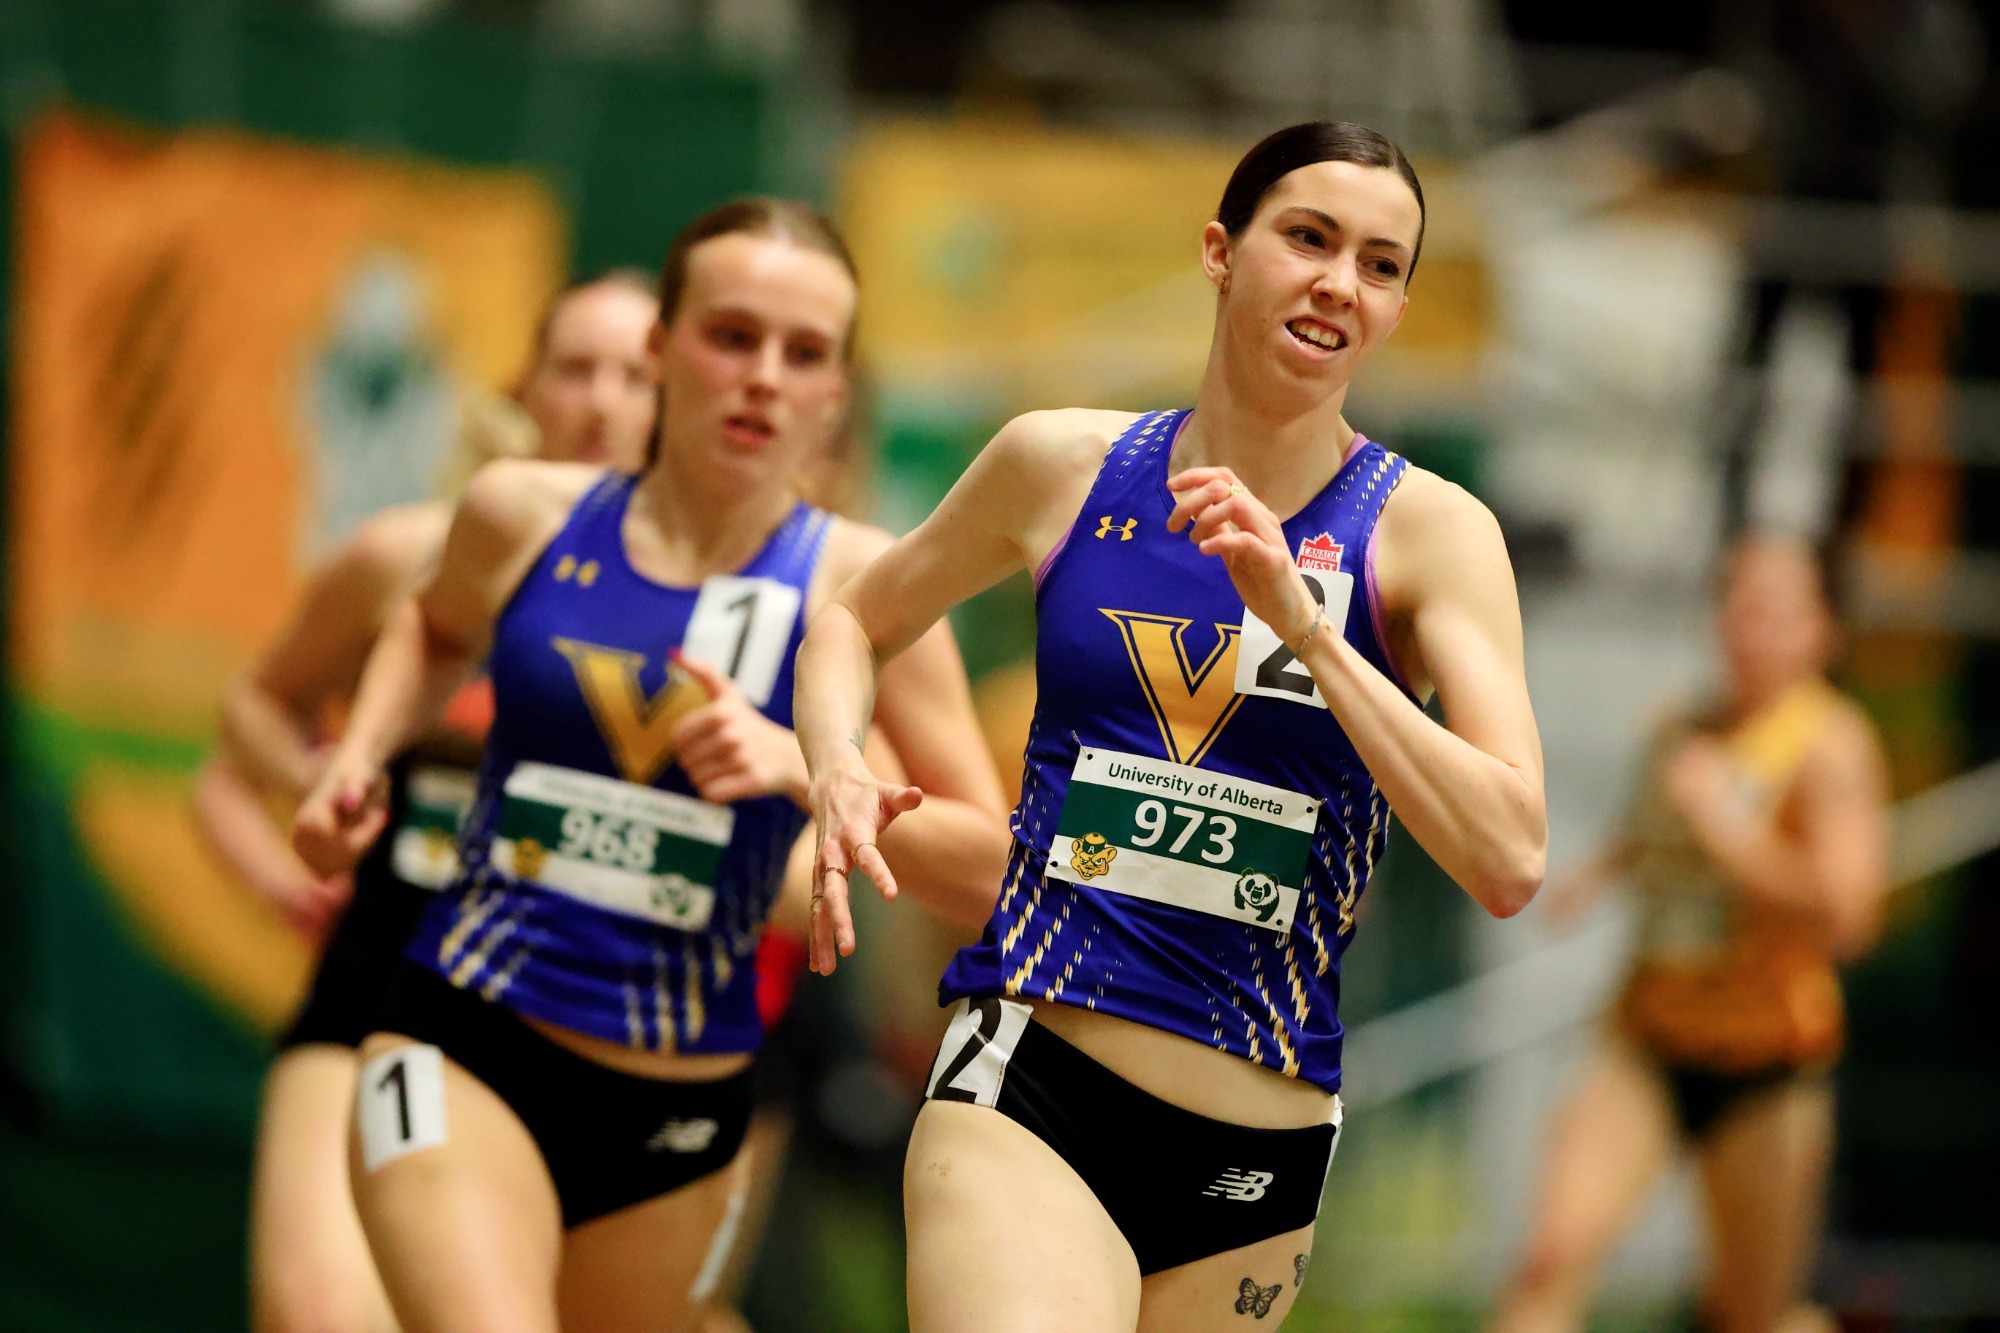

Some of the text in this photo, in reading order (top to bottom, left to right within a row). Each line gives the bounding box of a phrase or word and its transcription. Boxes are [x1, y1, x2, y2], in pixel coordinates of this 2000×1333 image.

[1303, 546, 1337, 562] CANADA
[1303, 557, 1336, 571] WEST
[726, 591, 759, 680] 1
[1256, 573, 1326, 697] 2
[1097, 607, 1247, 767] V
[1108, 763, 1283, 816] University of Alberta
[559, 807, 659, 873] 968
[1131, 799, 1238, 864] 973
[932, 996, 1002, 1104] 2
[377, 1057, 411, 1144] 1
